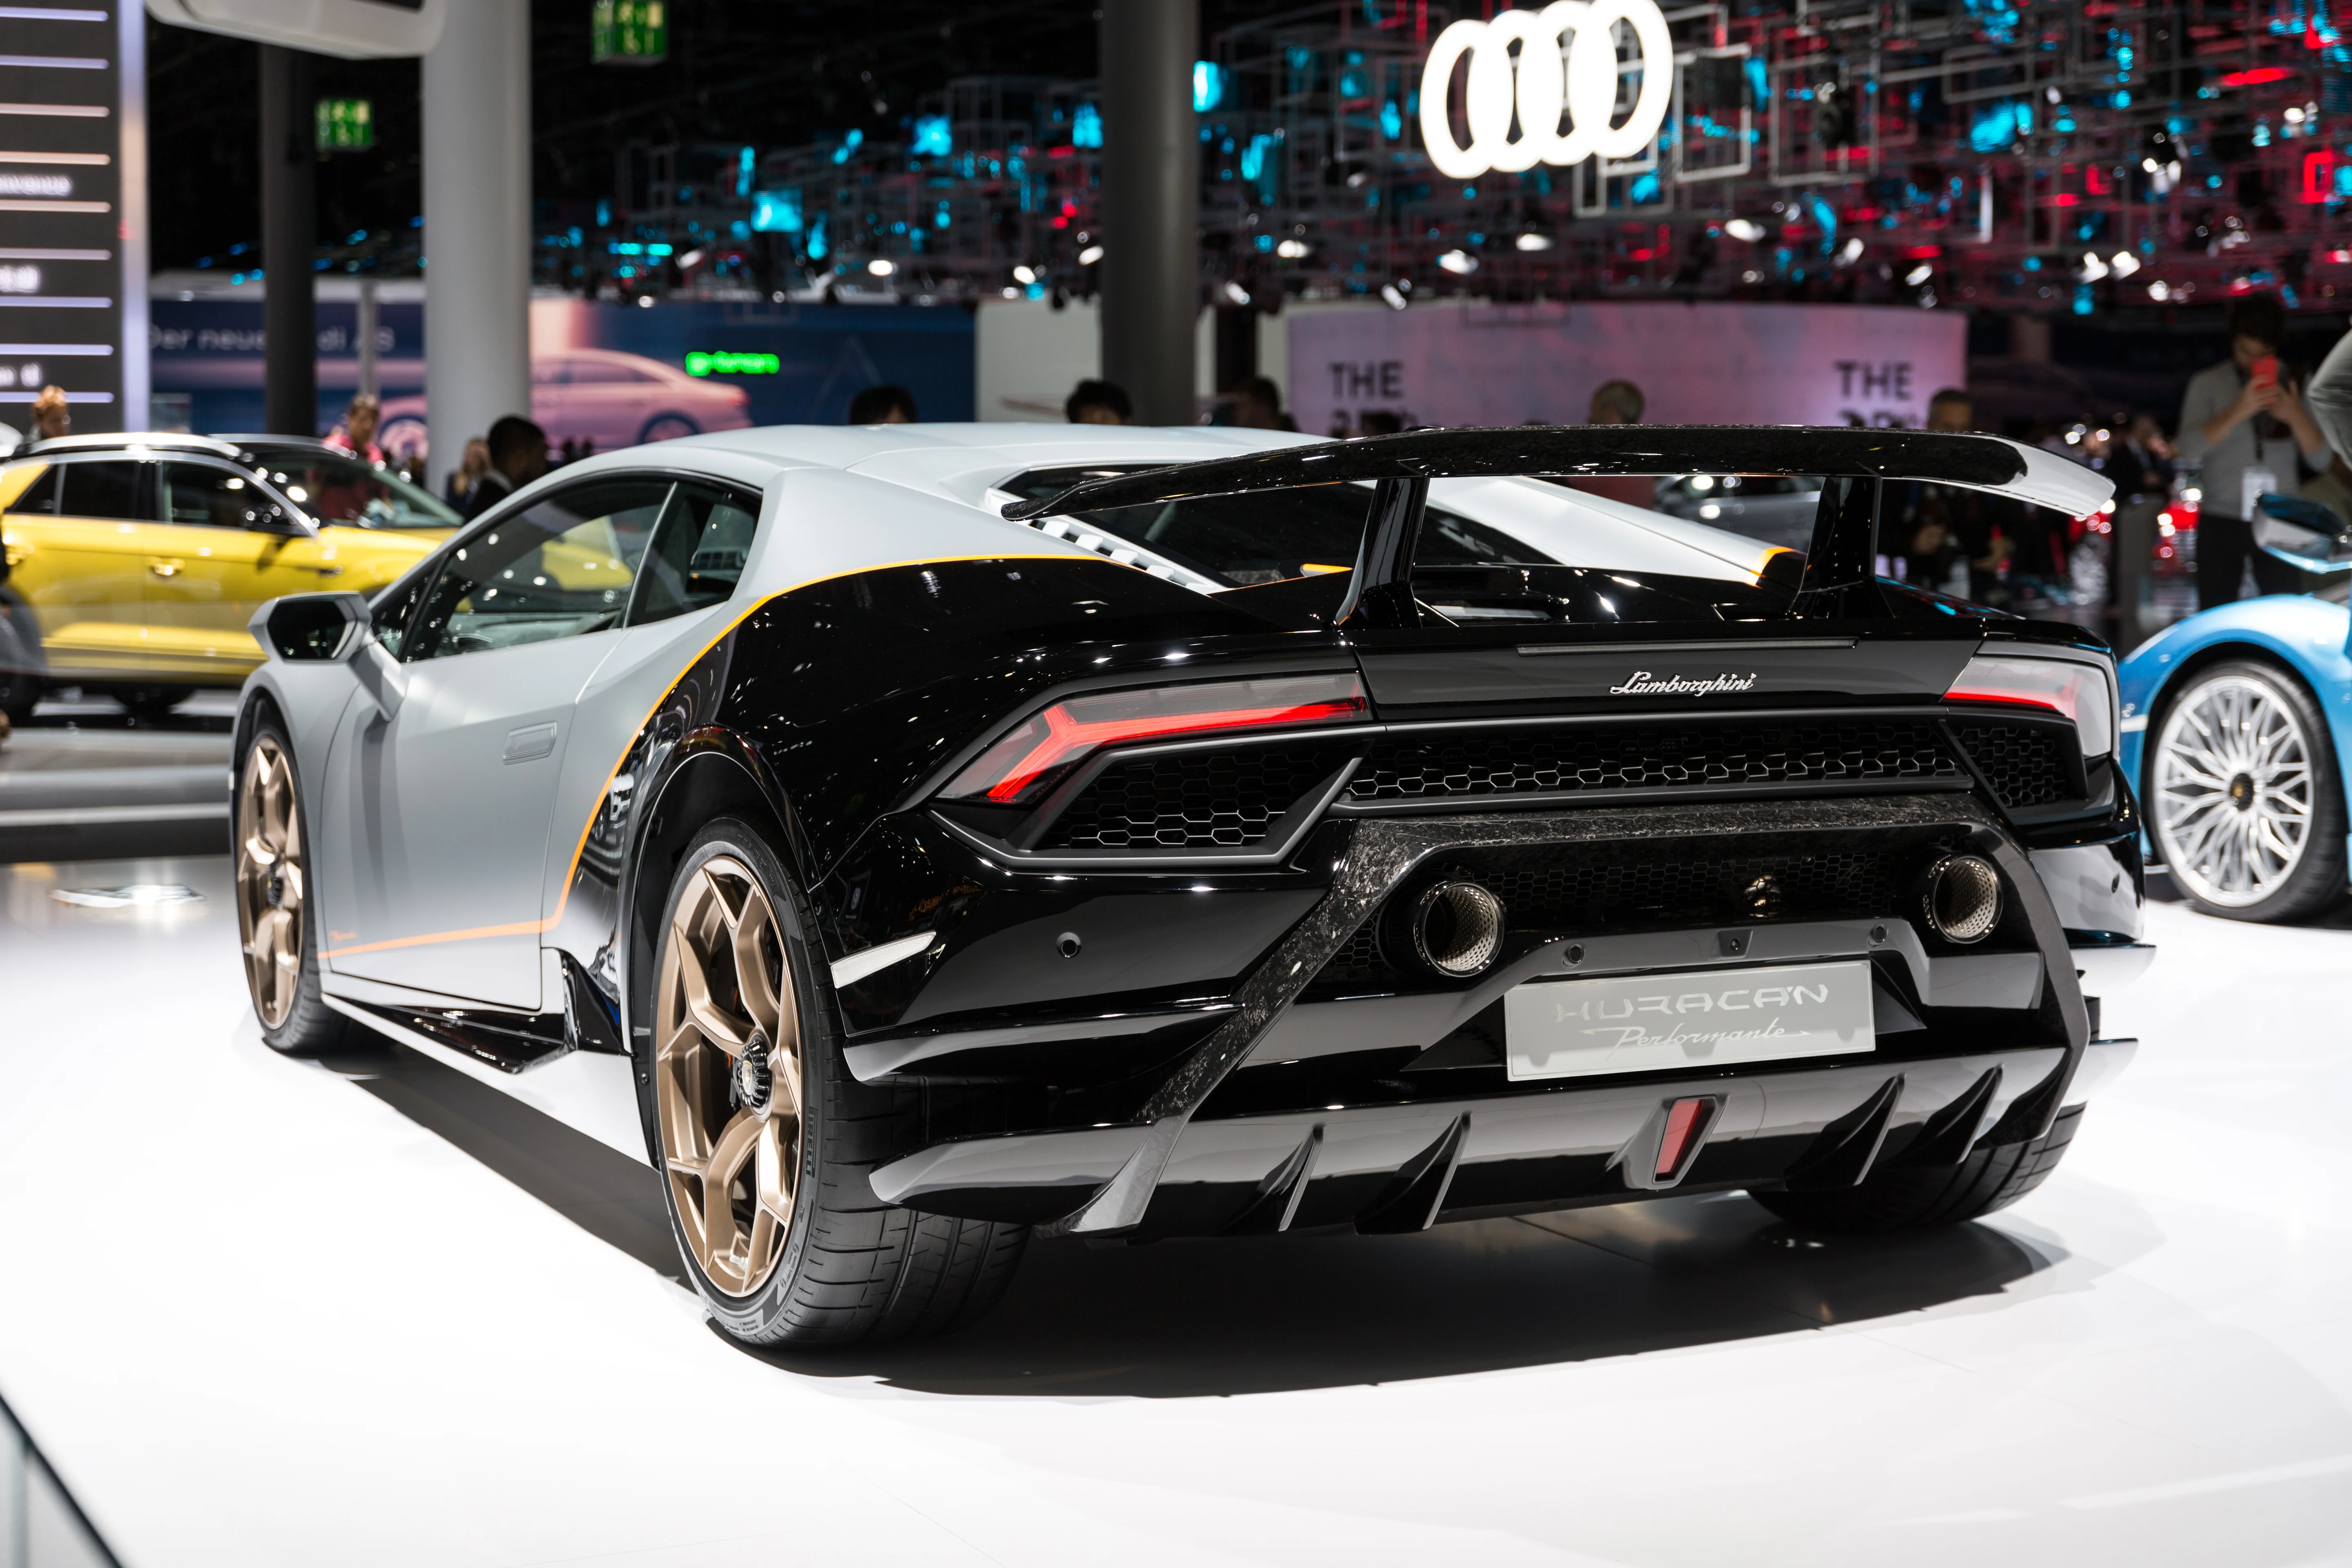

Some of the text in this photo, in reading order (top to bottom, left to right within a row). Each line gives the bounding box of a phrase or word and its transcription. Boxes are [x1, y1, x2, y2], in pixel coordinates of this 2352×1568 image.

[1329, 361, 1406, 400] THE
[1833, 359, 1915, 401] THE
[1609, 670, 1757, 697] Lamborghini
[1579, 1017, 1811, 1061] Performante
